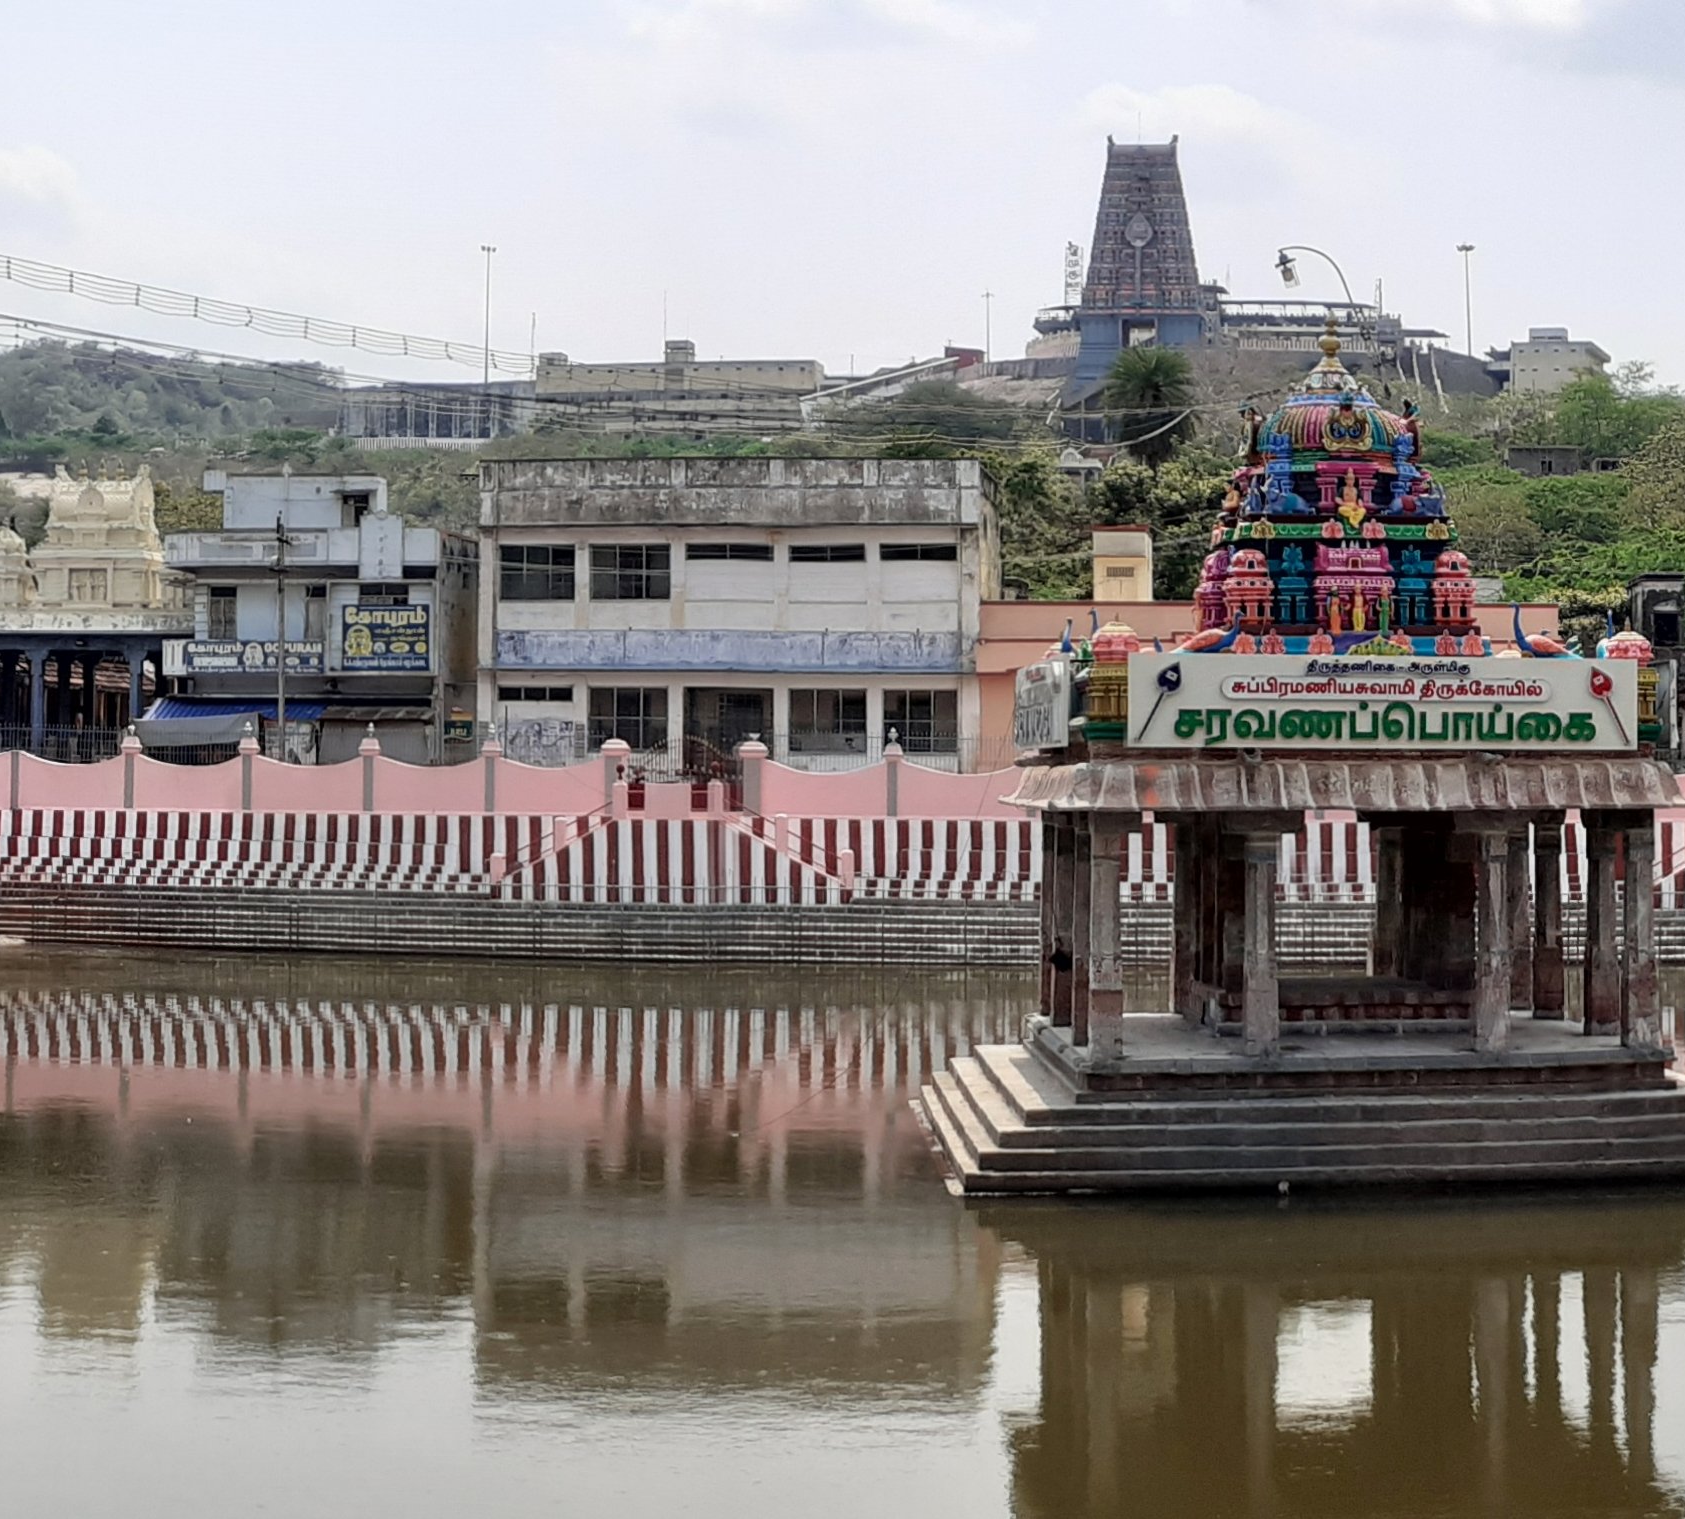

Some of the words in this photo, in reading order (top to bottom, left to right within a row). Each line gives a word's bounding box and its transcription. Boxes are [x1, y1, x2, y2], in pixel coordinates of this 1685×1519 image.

[345, 606, 427, 627] கோபுரம்
[187, 642, 244, 655] கோபுரம்
[1306, 660, 1395, 676] திருத்தணிகை
[1407, 660, 1471, 676] அருள்மிகு
[1231, 676, 1416, 698] சுப்பிரமணியசுவாமி
[1420, 678, 1543, 699] திருக்கோயில்
[1174, 700, 1596, 745] சரவணப்பொய்கை
